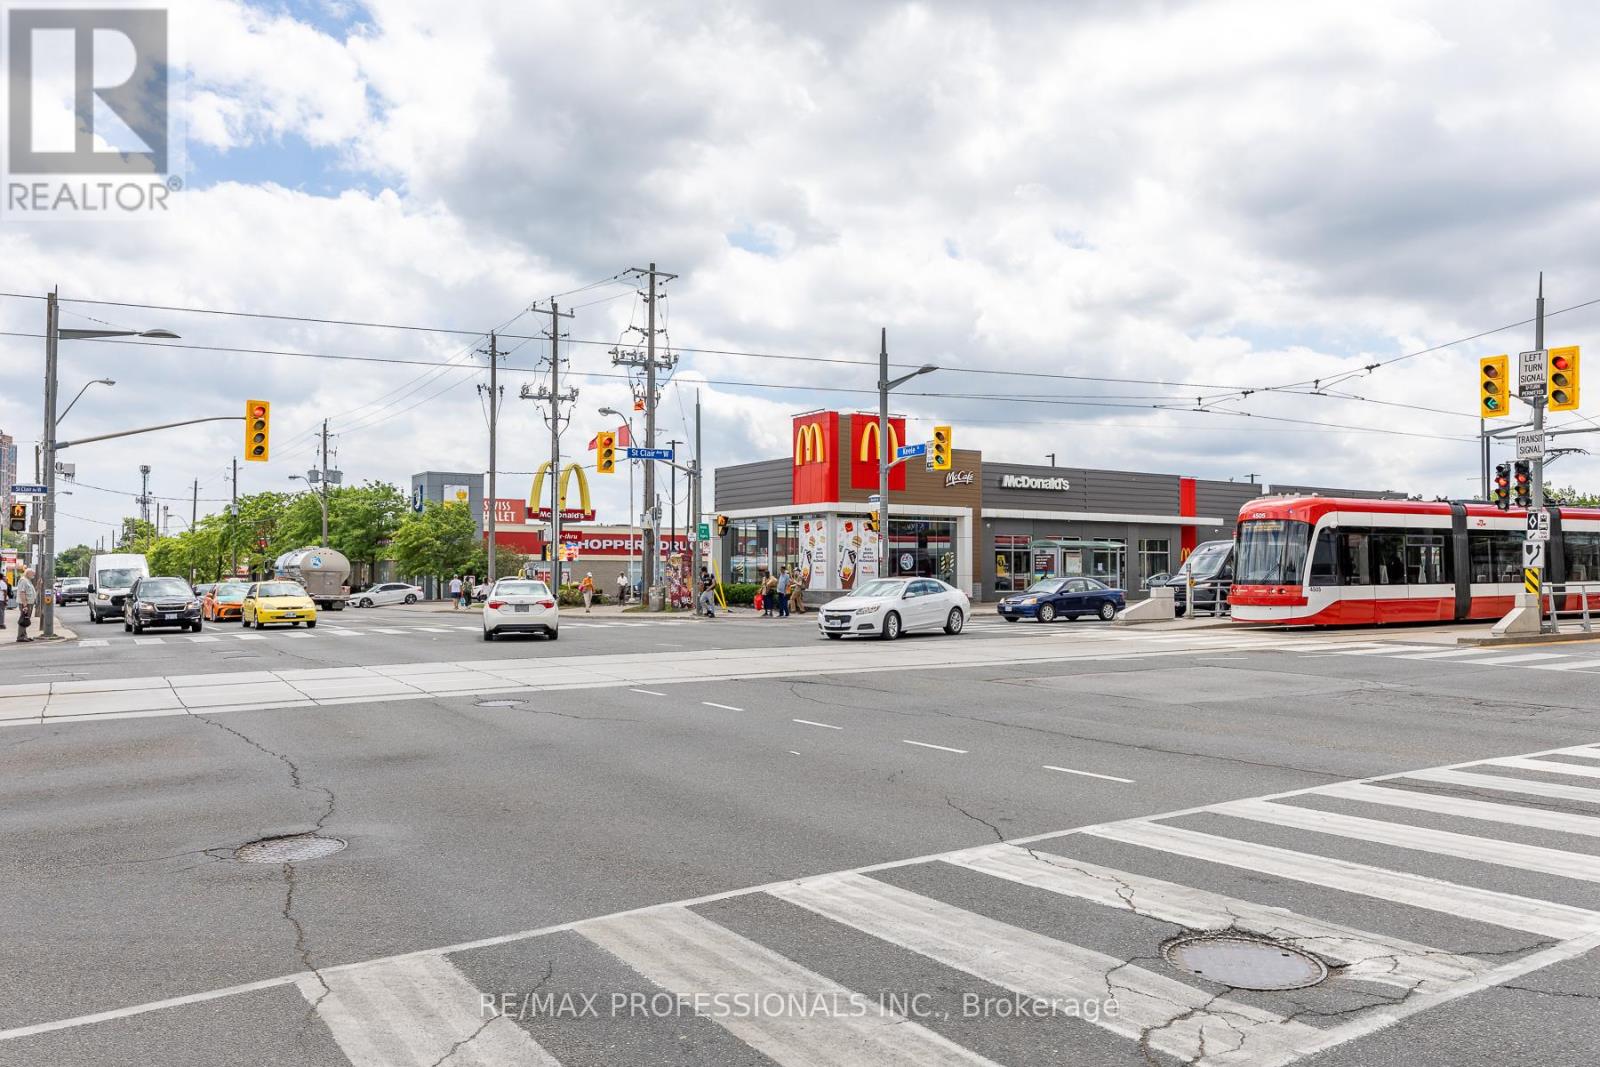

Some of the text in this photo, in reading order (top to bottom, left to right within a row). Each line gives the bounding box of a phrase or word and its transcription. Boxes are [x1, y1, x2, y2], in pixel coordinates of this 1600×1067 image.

[1524, 353, 1542, 363] LEFT
[1524, 363, 1543, 373] TURN
[1520, 373, 1545, 384] SIGNAL
[1518, 434, 1543, 444] TRANSIT
[631, 449, 639, 457] St
[640, 449, 656, 457] Clair
[663, 450, 670, 458] W
[902, 446, 916, 456] Keele
[1519, 444, 1542, 455] SIGNAL
[1001, 474, 1070, 491] McDonald's
[578, 540, 645, 551] HOPPER
